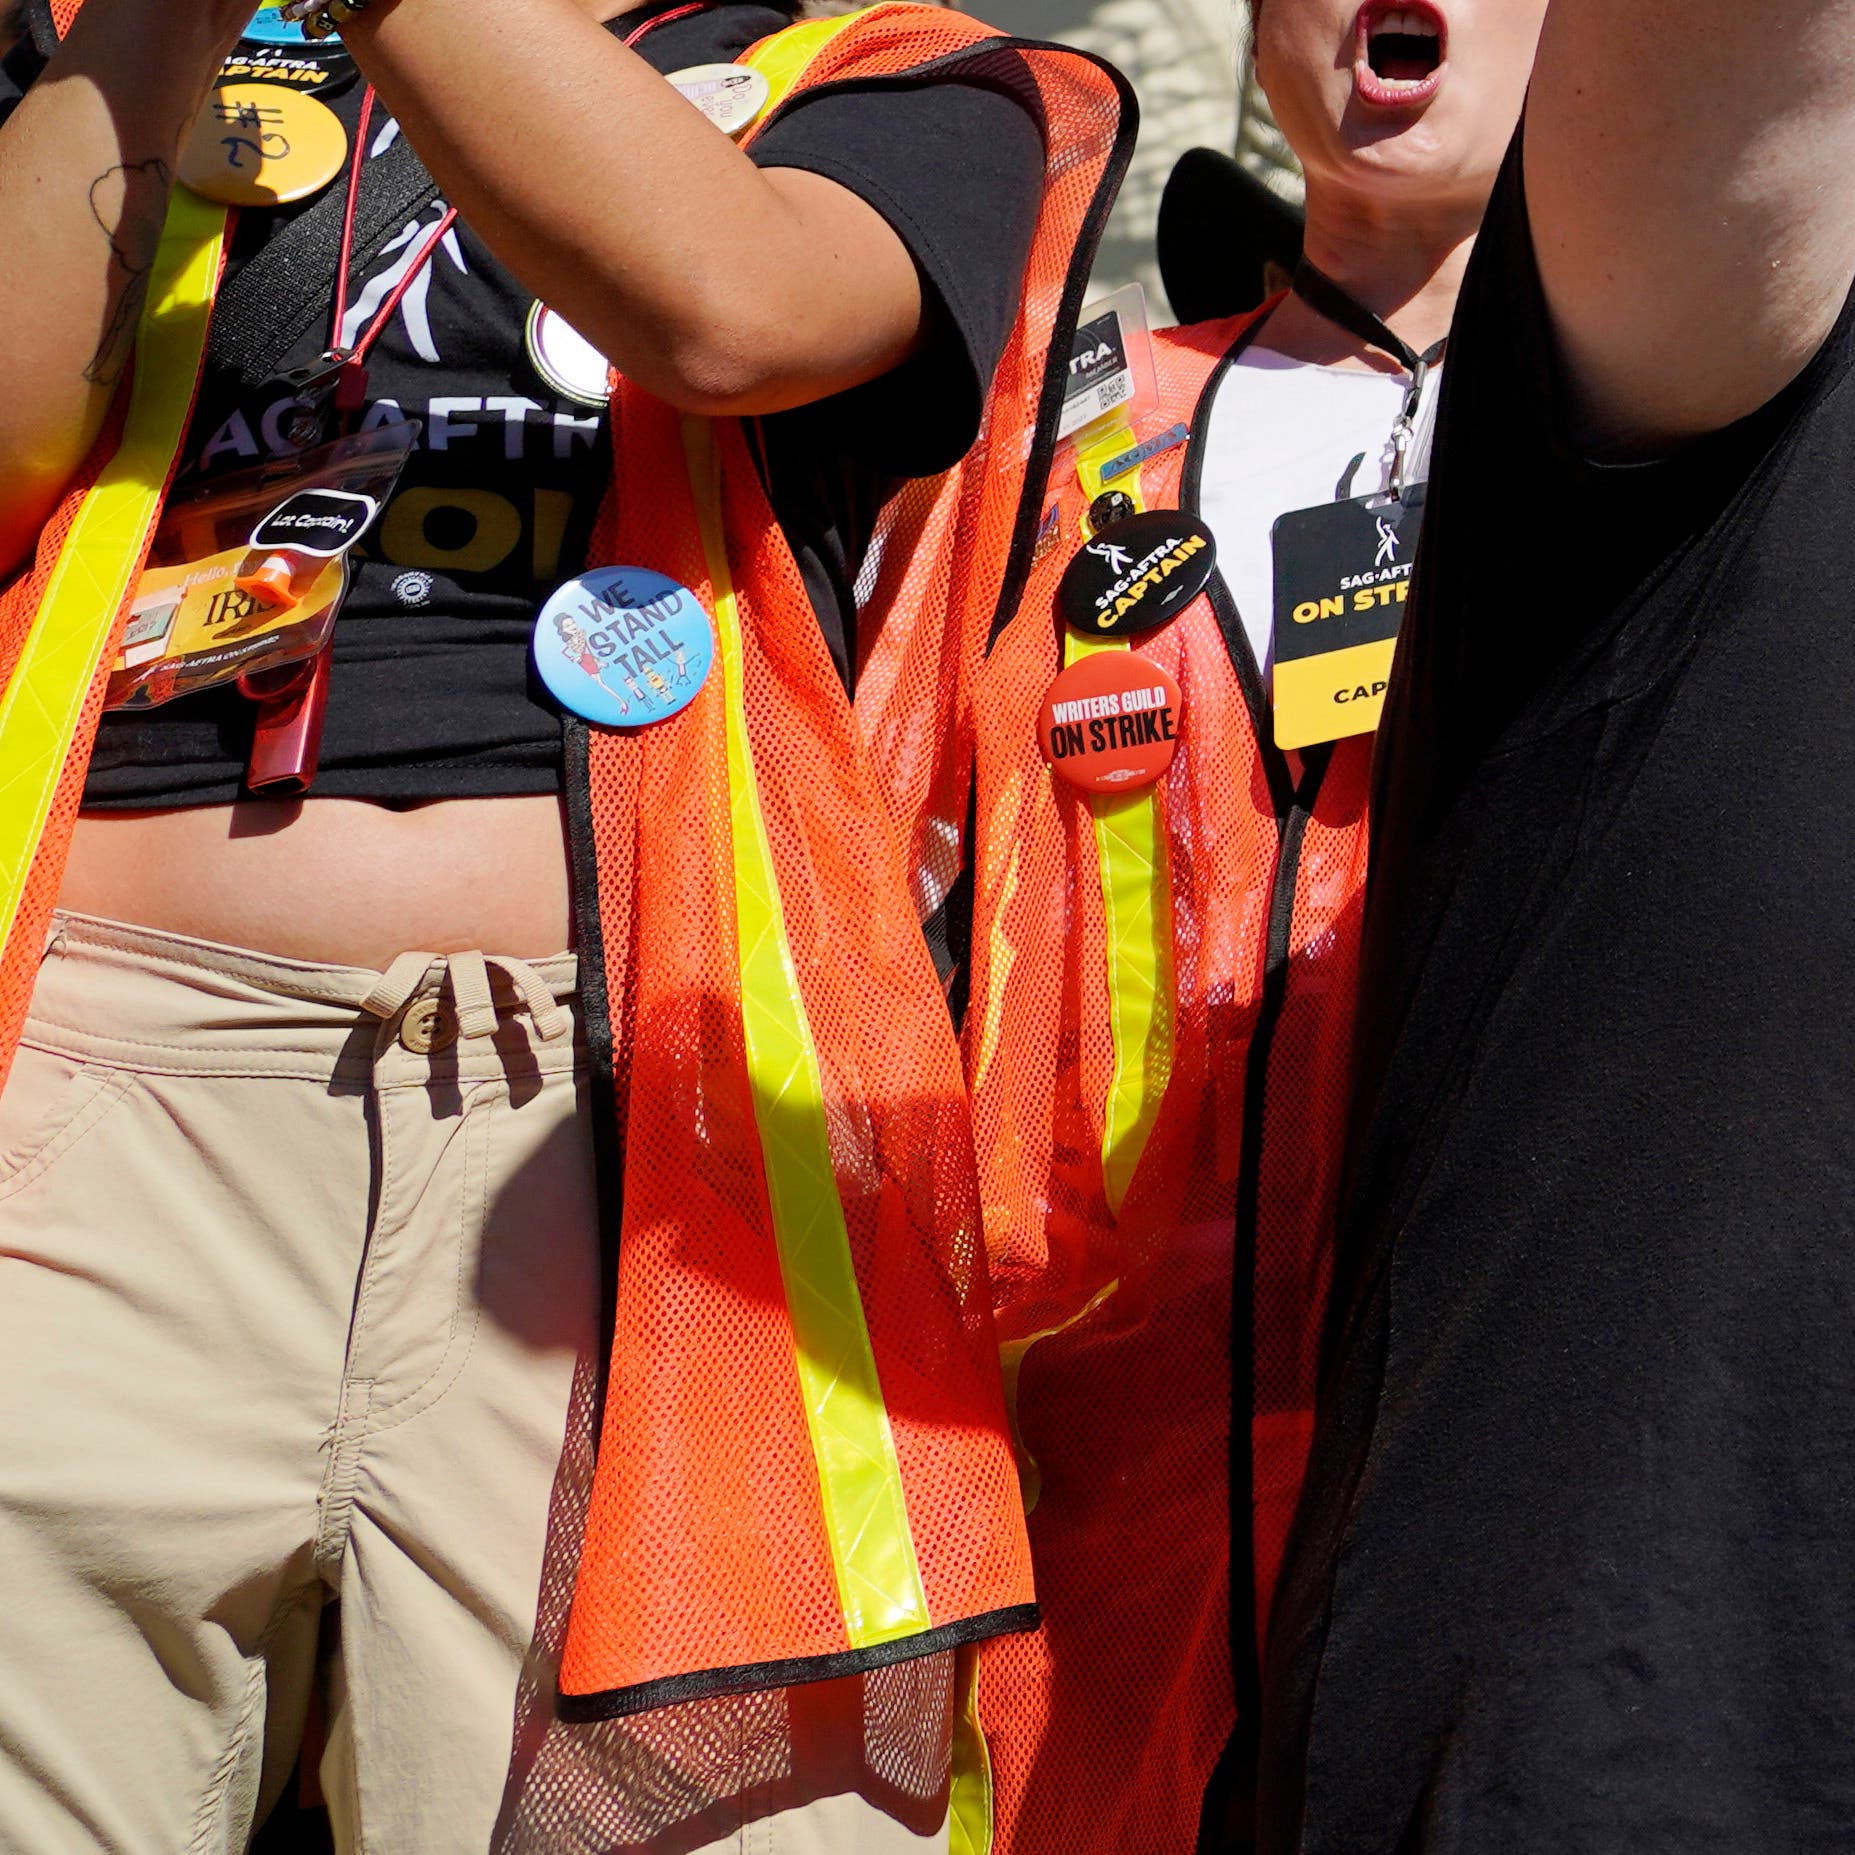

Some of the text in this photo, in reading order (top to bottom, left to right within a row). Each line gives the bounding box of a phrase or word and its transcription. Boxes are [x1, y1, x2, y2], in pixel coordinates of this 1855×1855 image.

[578, 580, 635, 624] WE
[1096, 535, 1207, 629] CAPTAIN
[588, 589, 684, 658] STAND
[1292, 595, 1344, 624] ON
[613, 630, 684, 679] TALL
[1052, 686, 1167, 724] WRITERS GUILD
[1050, 707, 1176, 760] ON STRIKE
